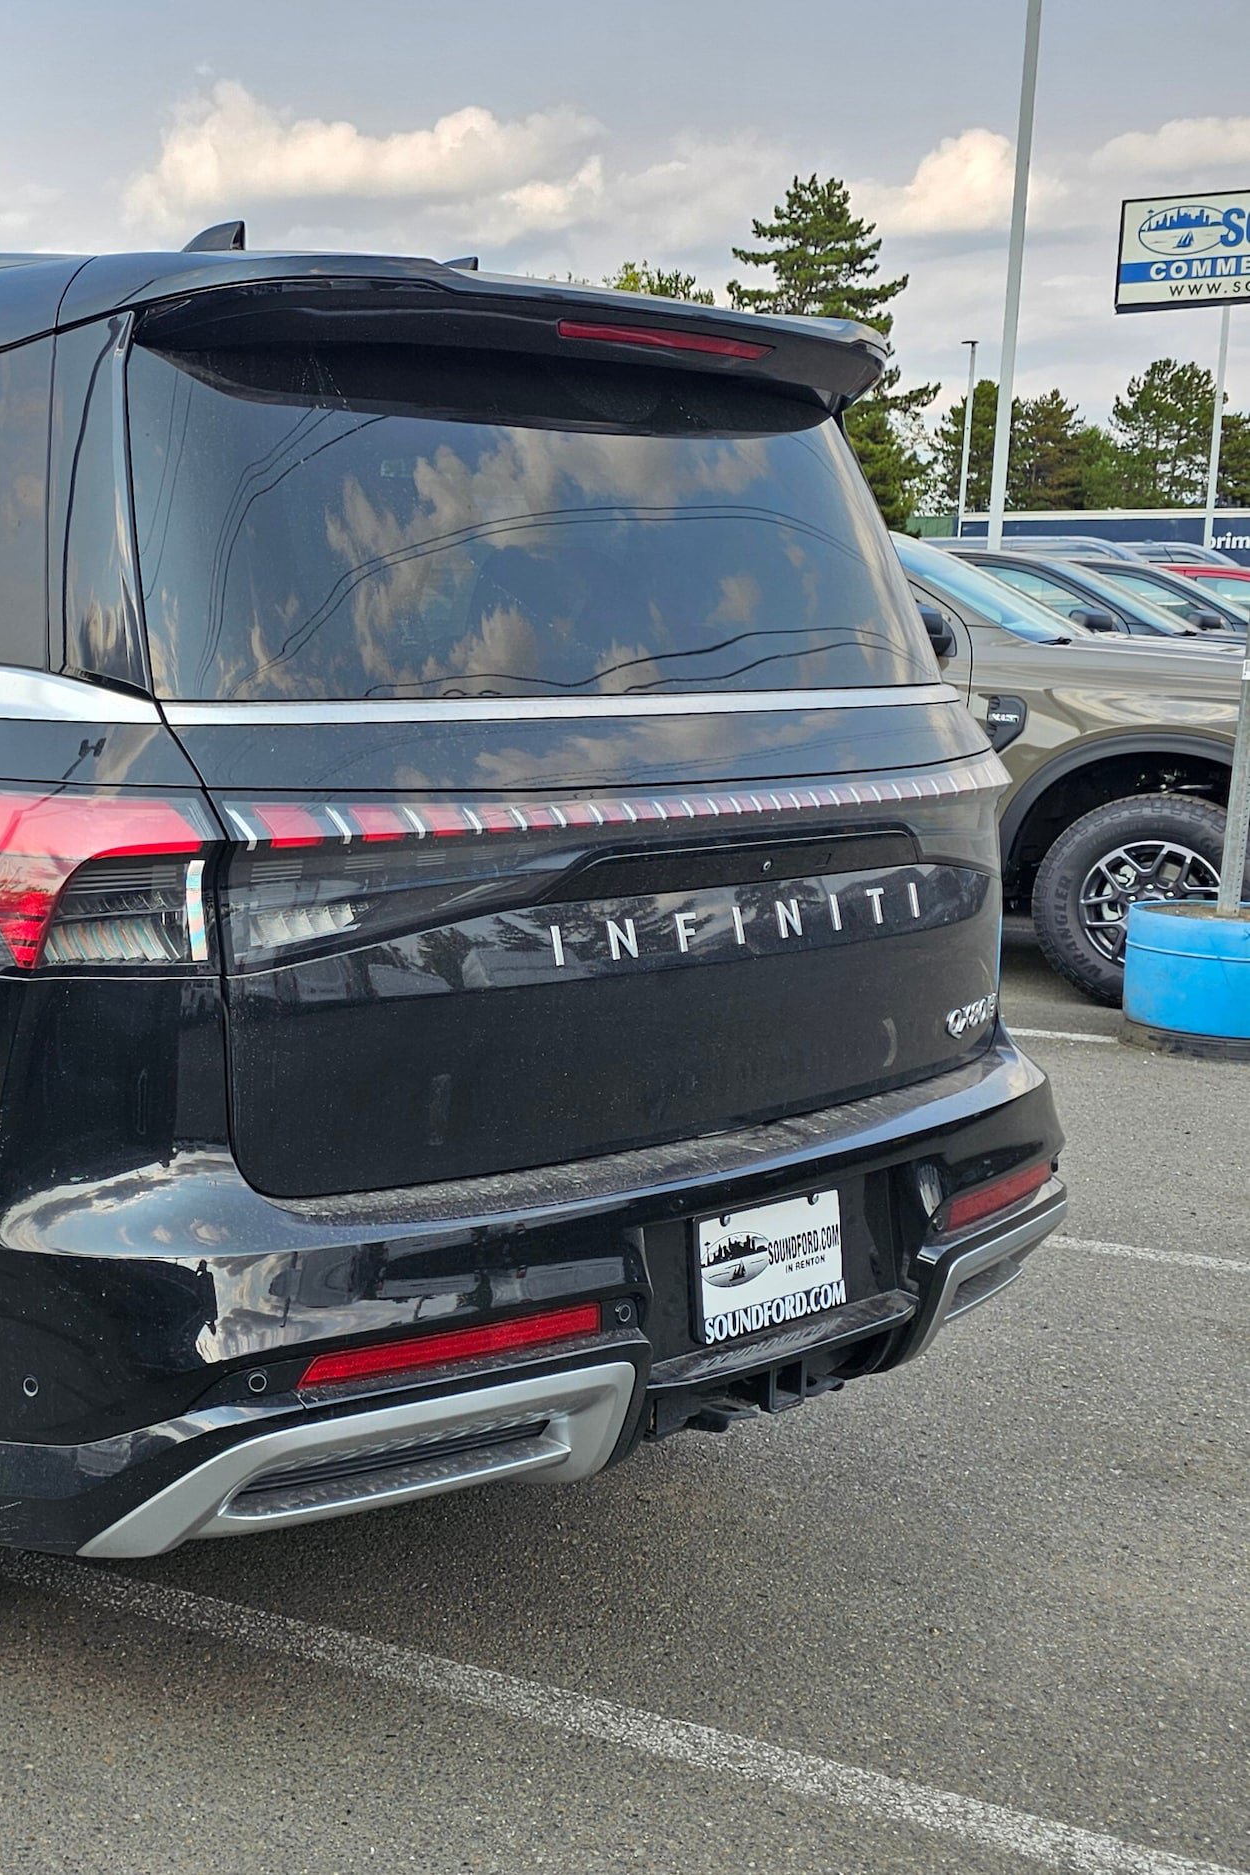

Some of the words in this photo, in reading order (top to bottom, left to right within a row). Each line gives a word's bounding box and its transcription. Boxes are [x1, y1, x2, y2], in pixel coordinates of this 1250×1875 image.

[1220, 208, 1250, 247] S
[550, 882, 921, 967] INFINITI
[1054, 875, 1104, 978] WRANGLER
[768, 1224, 840, 1266] SOUNDFORD.COM
[785, 1263, 793, 1274] IN
[795, 1254, 826, 1271] RENTON
[705, 1280, 847, 1345] SOUNDFORD.COM
